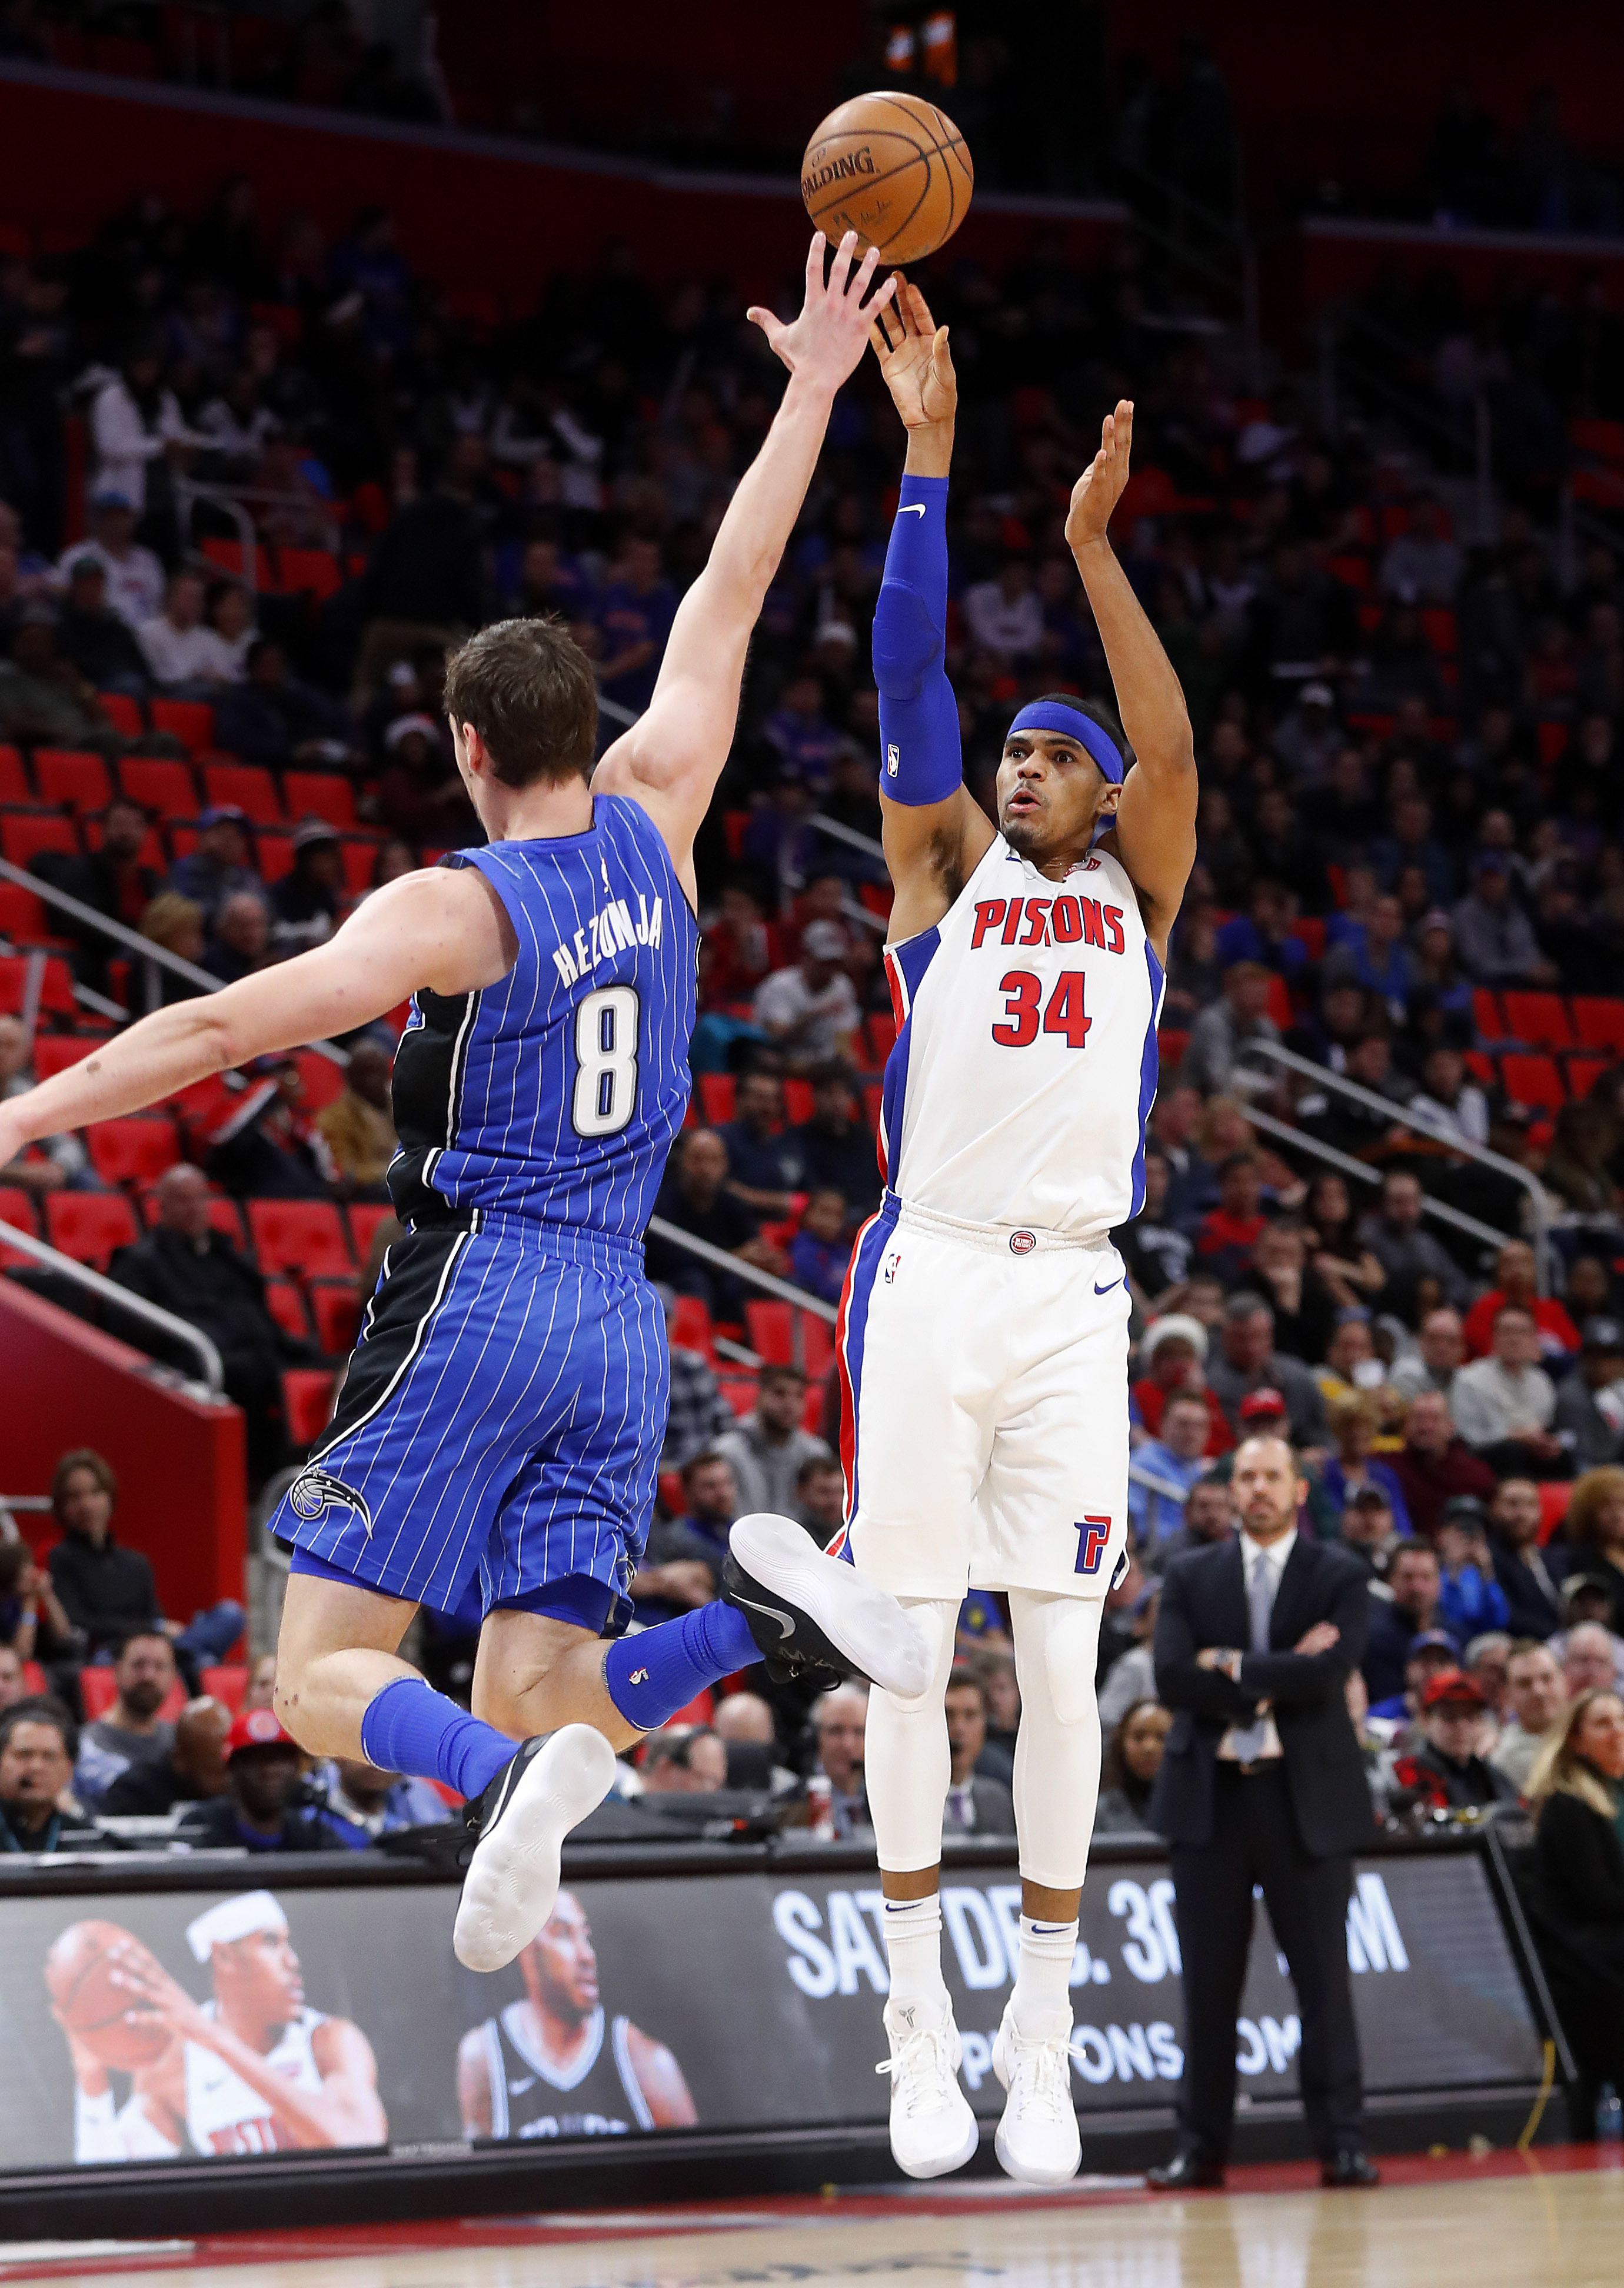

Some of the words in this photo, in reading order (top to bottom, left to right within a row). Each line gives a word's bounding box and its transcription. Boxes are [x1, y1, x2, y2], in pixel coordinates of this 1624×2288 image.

[552, 893, 663, 990] HEZONJA
[970, 895, 1125, 955] PISONS
[991, 970, 1093, 1049] 34
[571, 983, 640, 1138] 8
